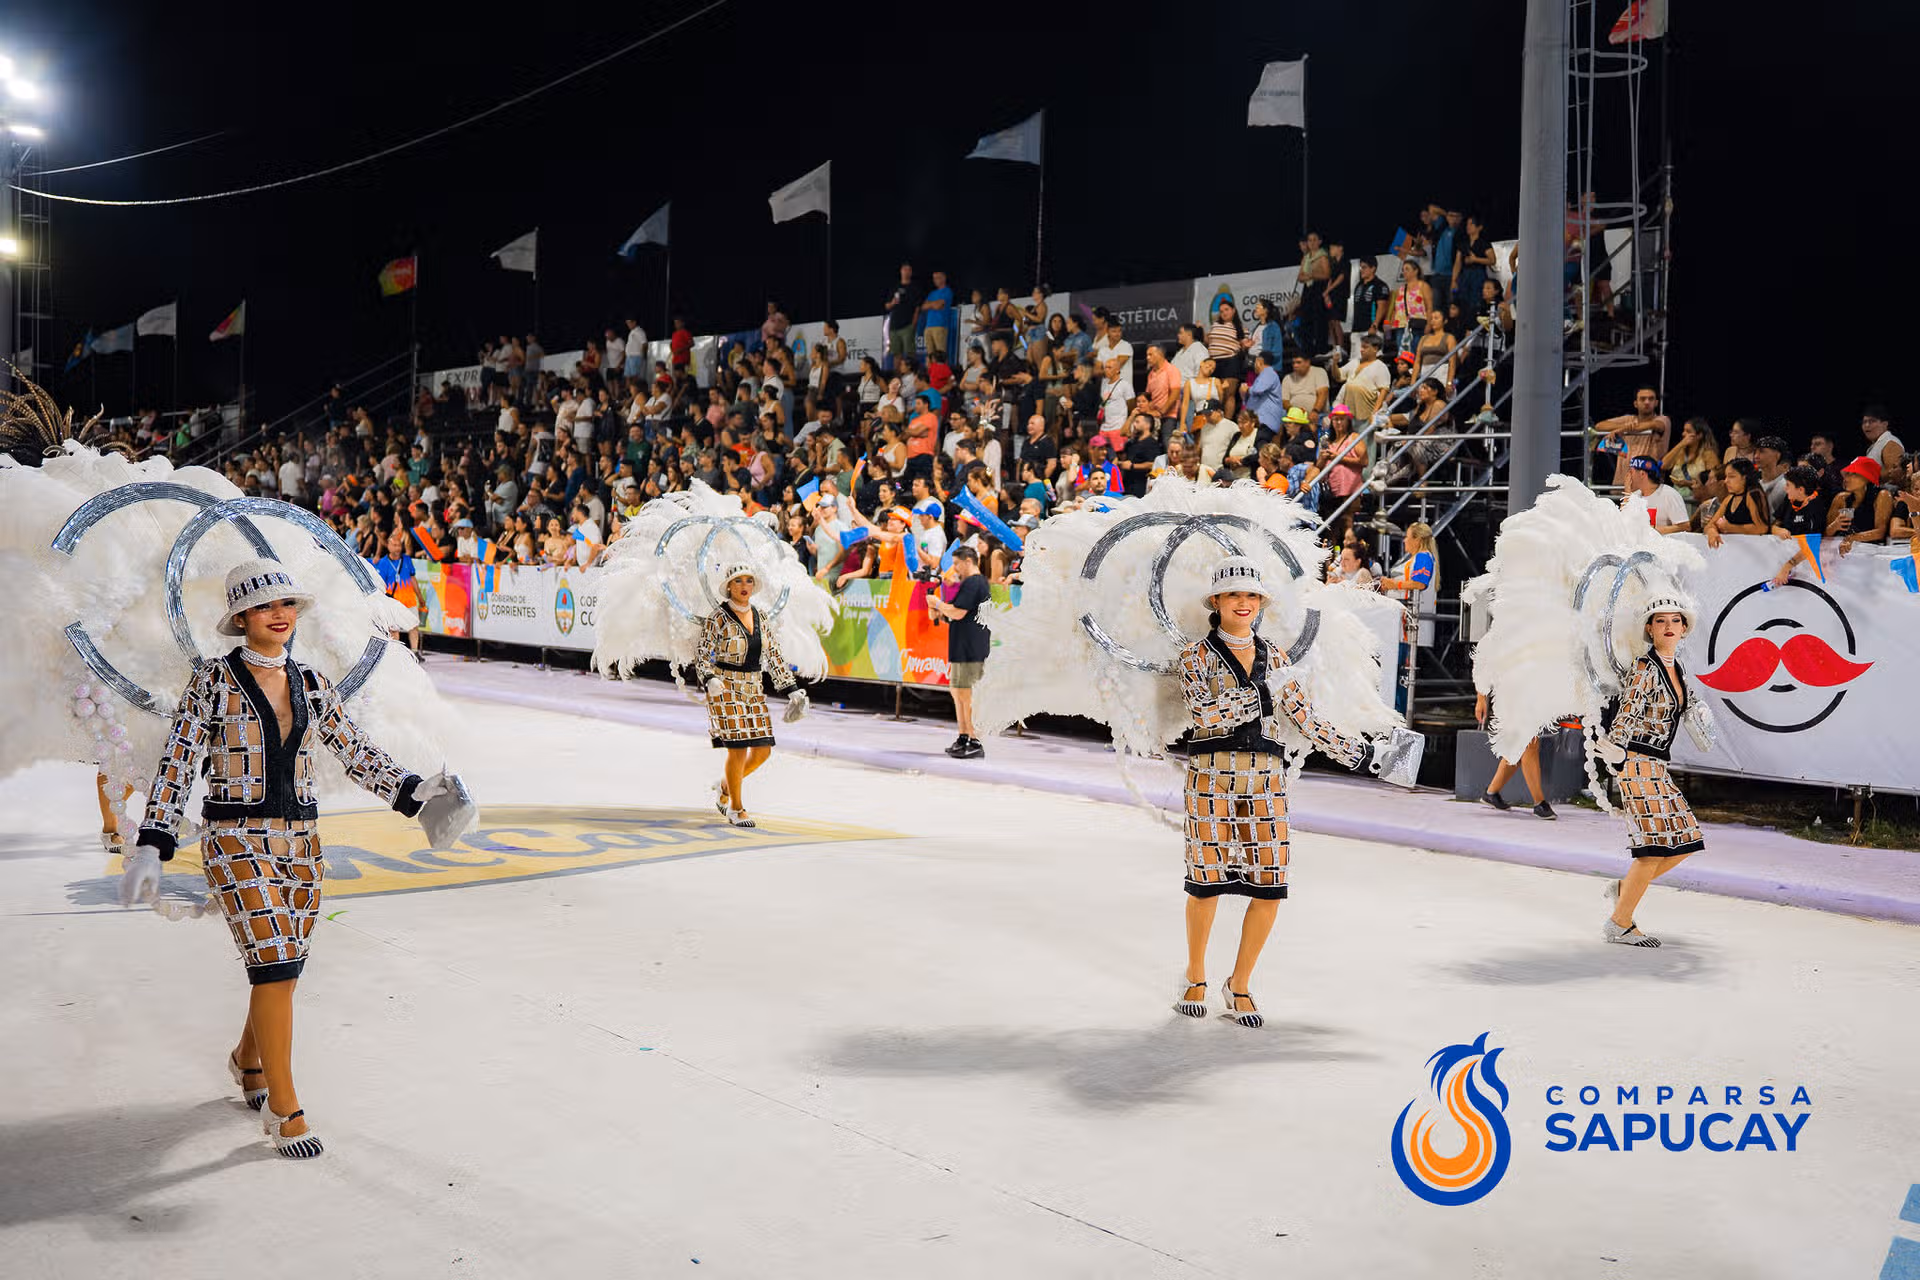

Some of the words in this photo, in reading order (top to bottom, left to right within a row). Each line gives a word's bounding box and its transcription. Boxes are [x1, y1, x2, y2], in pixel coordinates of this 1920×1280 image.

[1110, 306, 1178, 324] STÉTICA
[446, 369, 479, 384] EXPR
[491, 604, 536, 618] CORRIENTES
